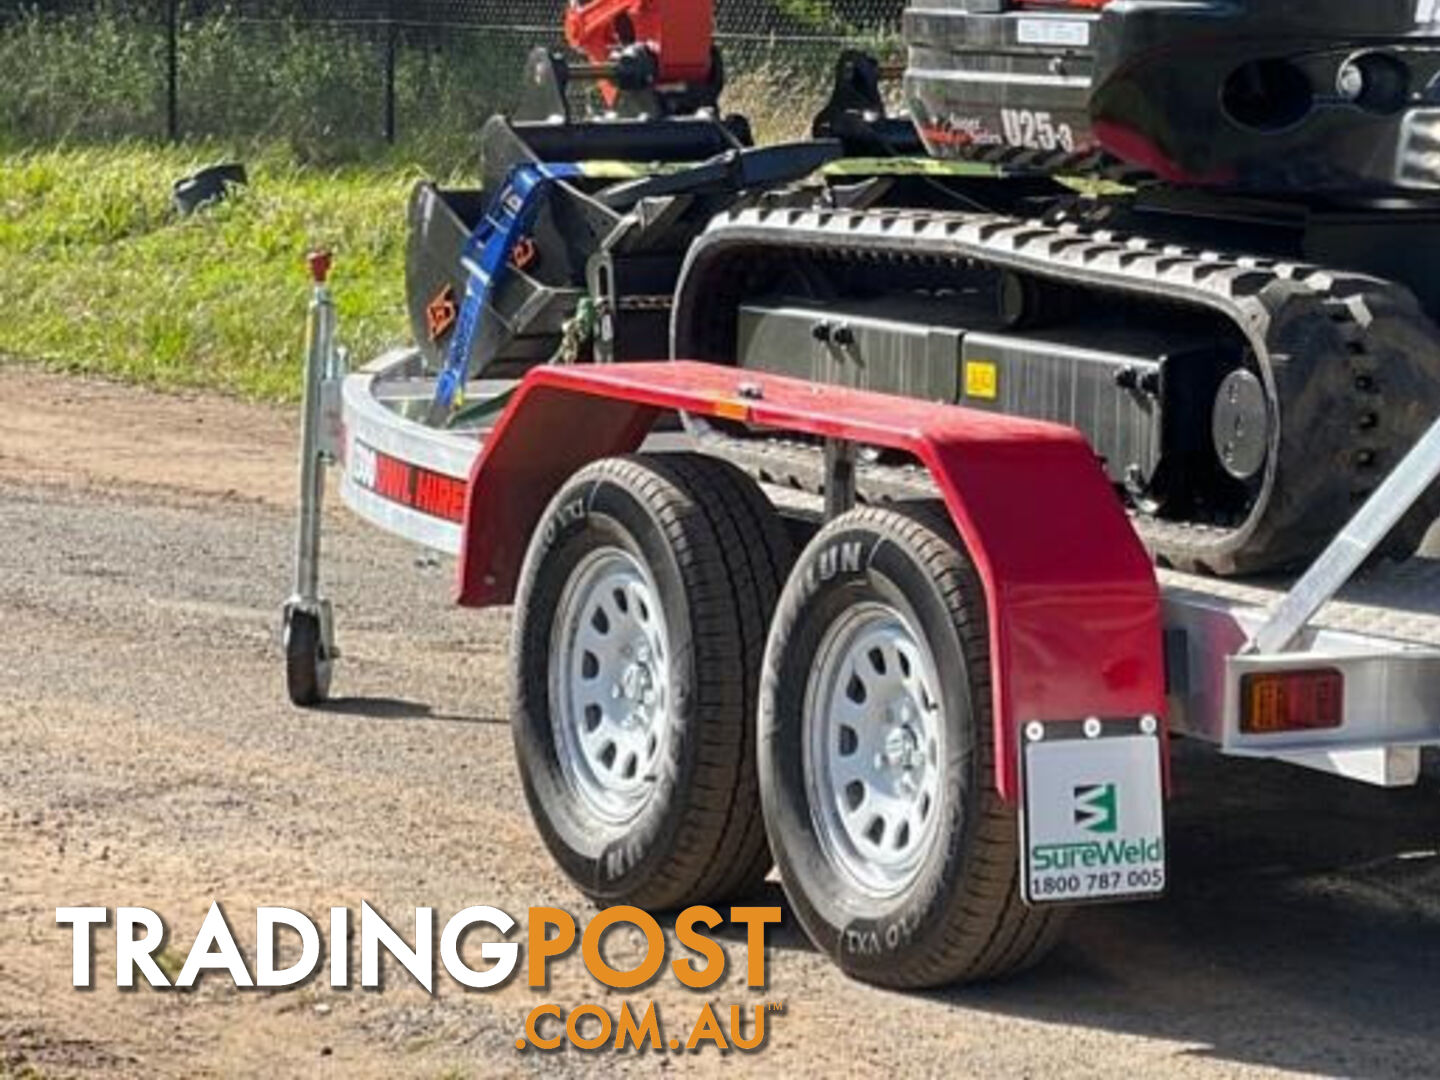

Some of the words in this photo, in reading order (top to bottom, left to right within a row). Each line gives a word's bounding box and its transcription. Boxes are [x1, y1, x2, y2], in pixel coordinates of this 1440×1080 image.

[1001, 108, 1073, 153] U25-3
[1032, 837, 1162, 871] SureWeld
[1033, 876, 1080, 895] 1800
[1085, 871, 1121, 891] 787
[1127, 868, 1163, 887] 005
